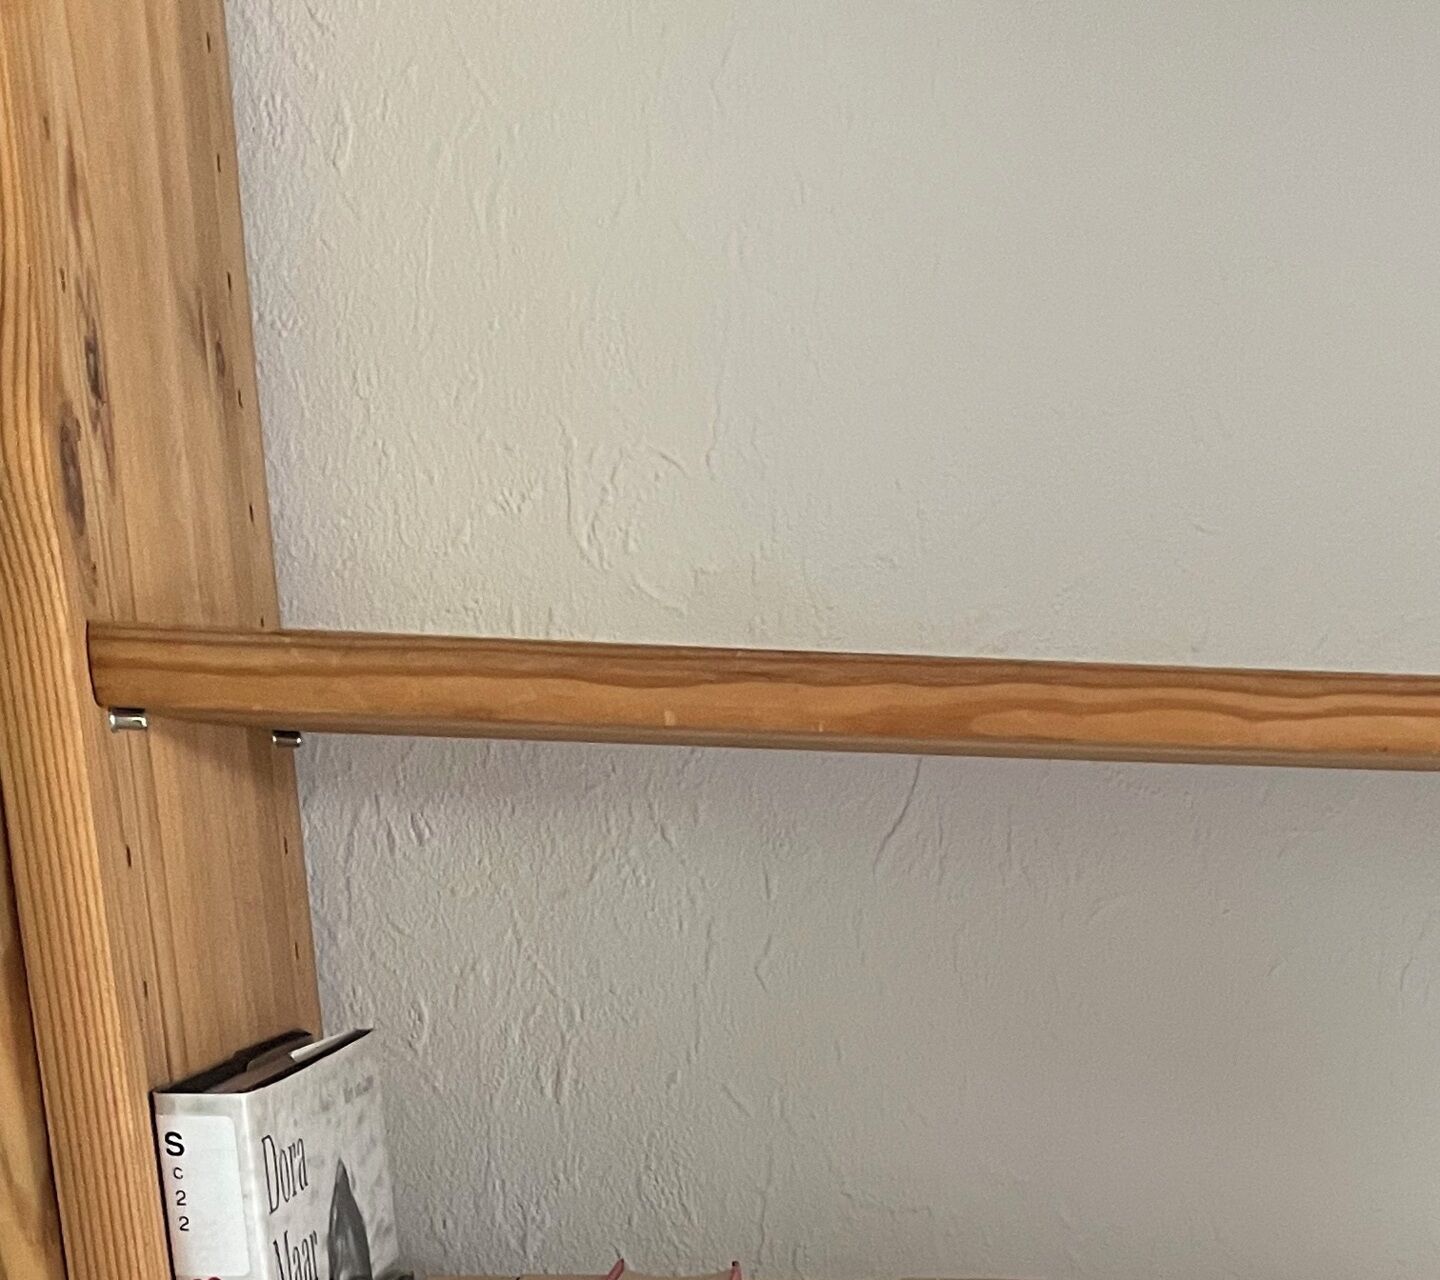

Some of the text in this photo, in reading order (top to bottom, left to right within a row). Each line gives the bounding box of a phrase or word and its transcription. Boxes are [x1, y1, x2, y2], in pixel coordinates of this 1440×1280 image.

[164, 1132, 185, 1157] S
[261, 1134, 310, 1216] Dora
[175, 1190, 187, 1208] 2
[178, 1216, 190, 1233] 2
